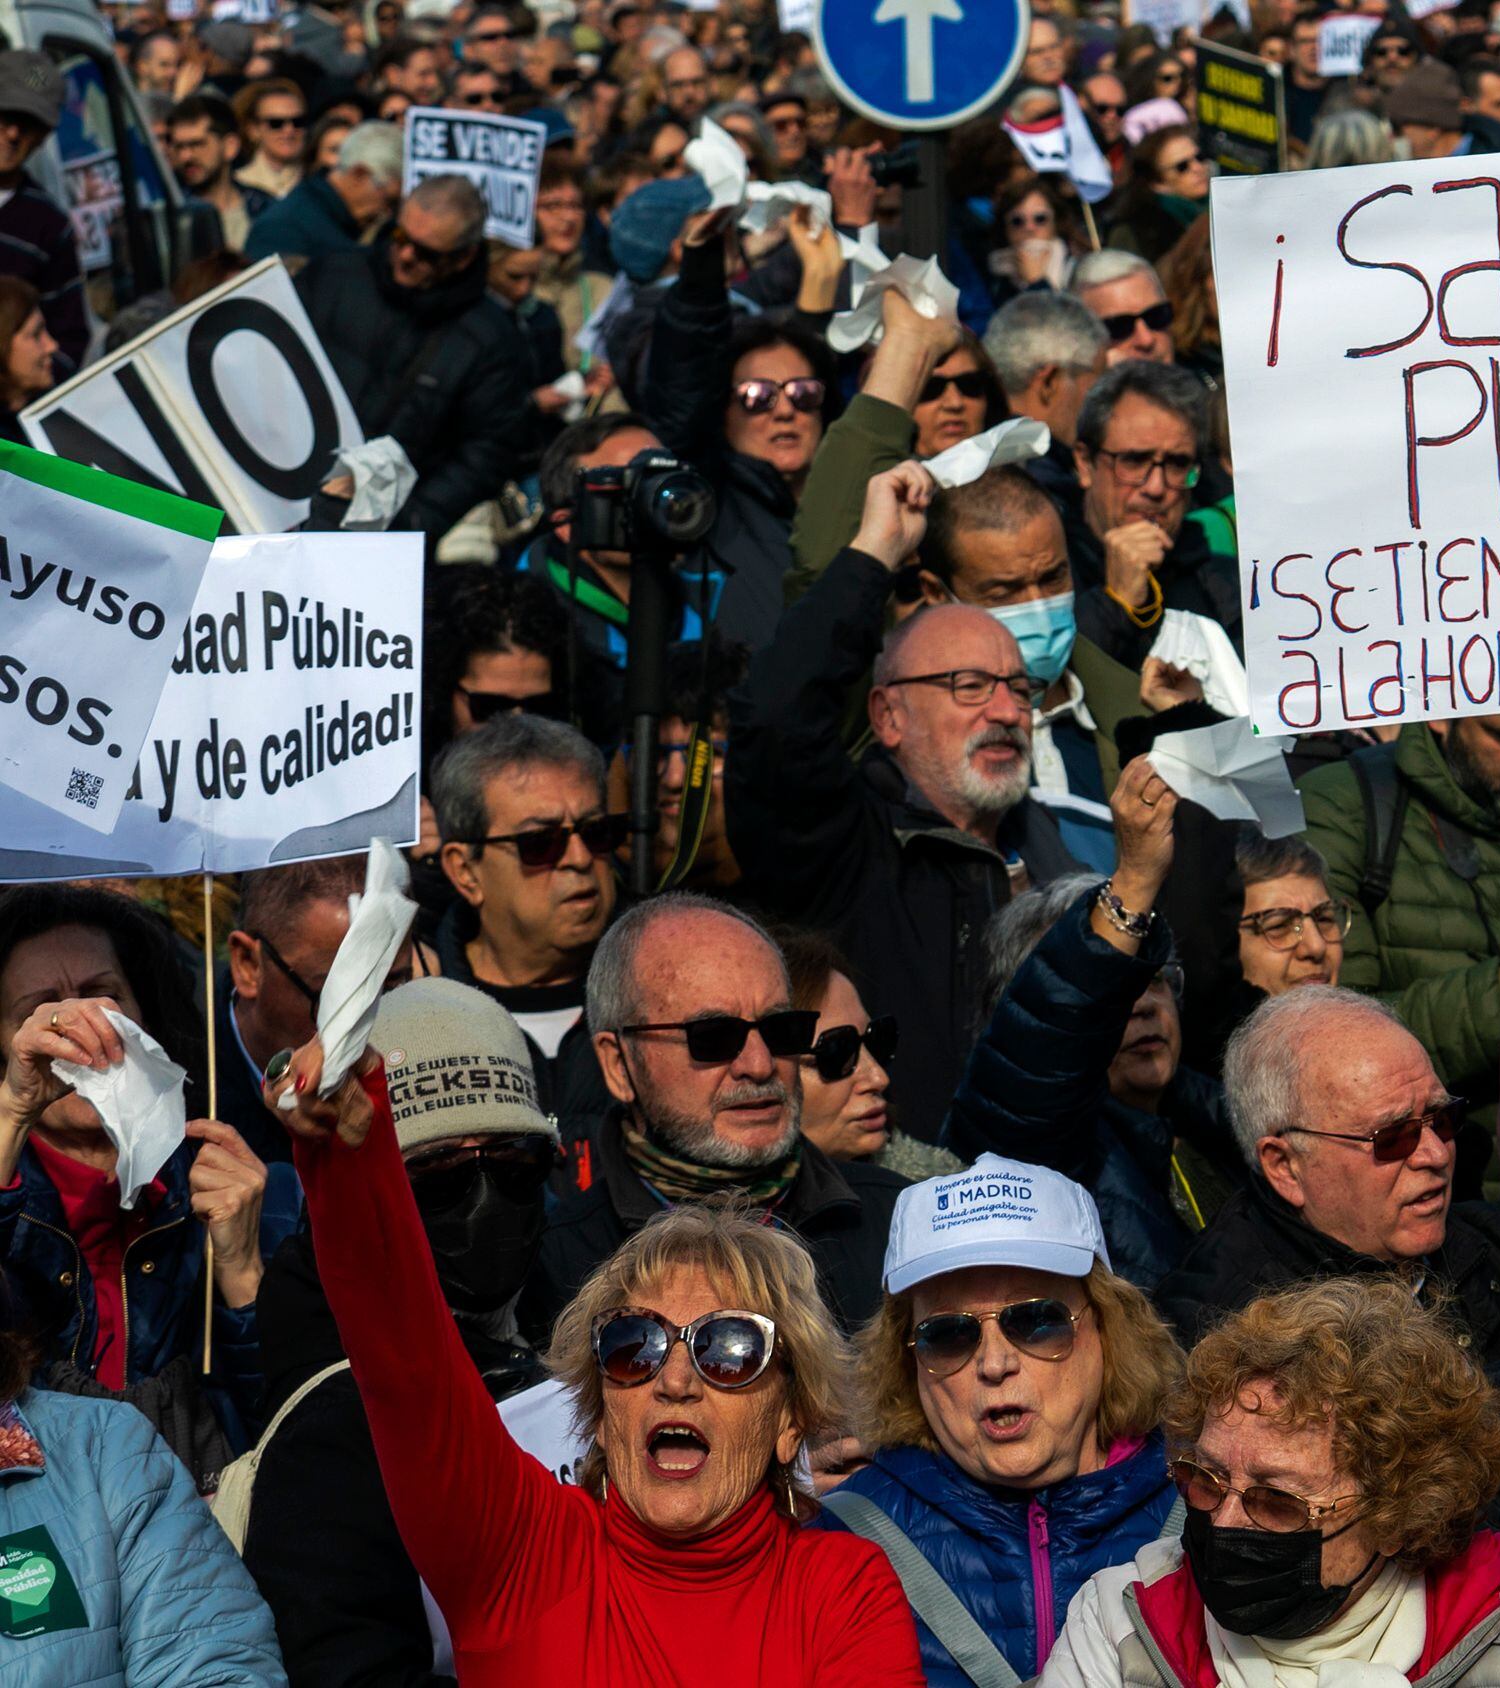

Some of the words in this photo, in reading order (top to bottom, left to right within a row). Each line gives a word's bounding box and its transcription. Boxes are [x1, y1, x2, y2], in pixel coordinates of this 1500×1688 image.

[414, 119, 448, 158] SE
[451, 121, 538, 170] VENDE
[40, 297, 341, 534] NO
[0, 536, 166, 641] yuso
[263, 589, 414, 671] Pública
[154, 738, 181, 823] y
[195, 717, 248, 801] de
[260, 692, 414, 797] calidad!
[389, 1069, 538, 1105] ACKSIDE
[960, 1184, 1032, 1204] MADRID
[973, 1173, 986, 1182] es
[986, 1172, 1034, 1184] cuidarse
[931, 1208, 969, 1223] Ciudad
[969, 1201, 1019, 1214] amigable
[1019, 1206, 1039, 1214] con
[932, 1223, 946, 1232] las
[947, 1214, 990, 1230] personas
[991, 1212, 1034, 1222] mayores
